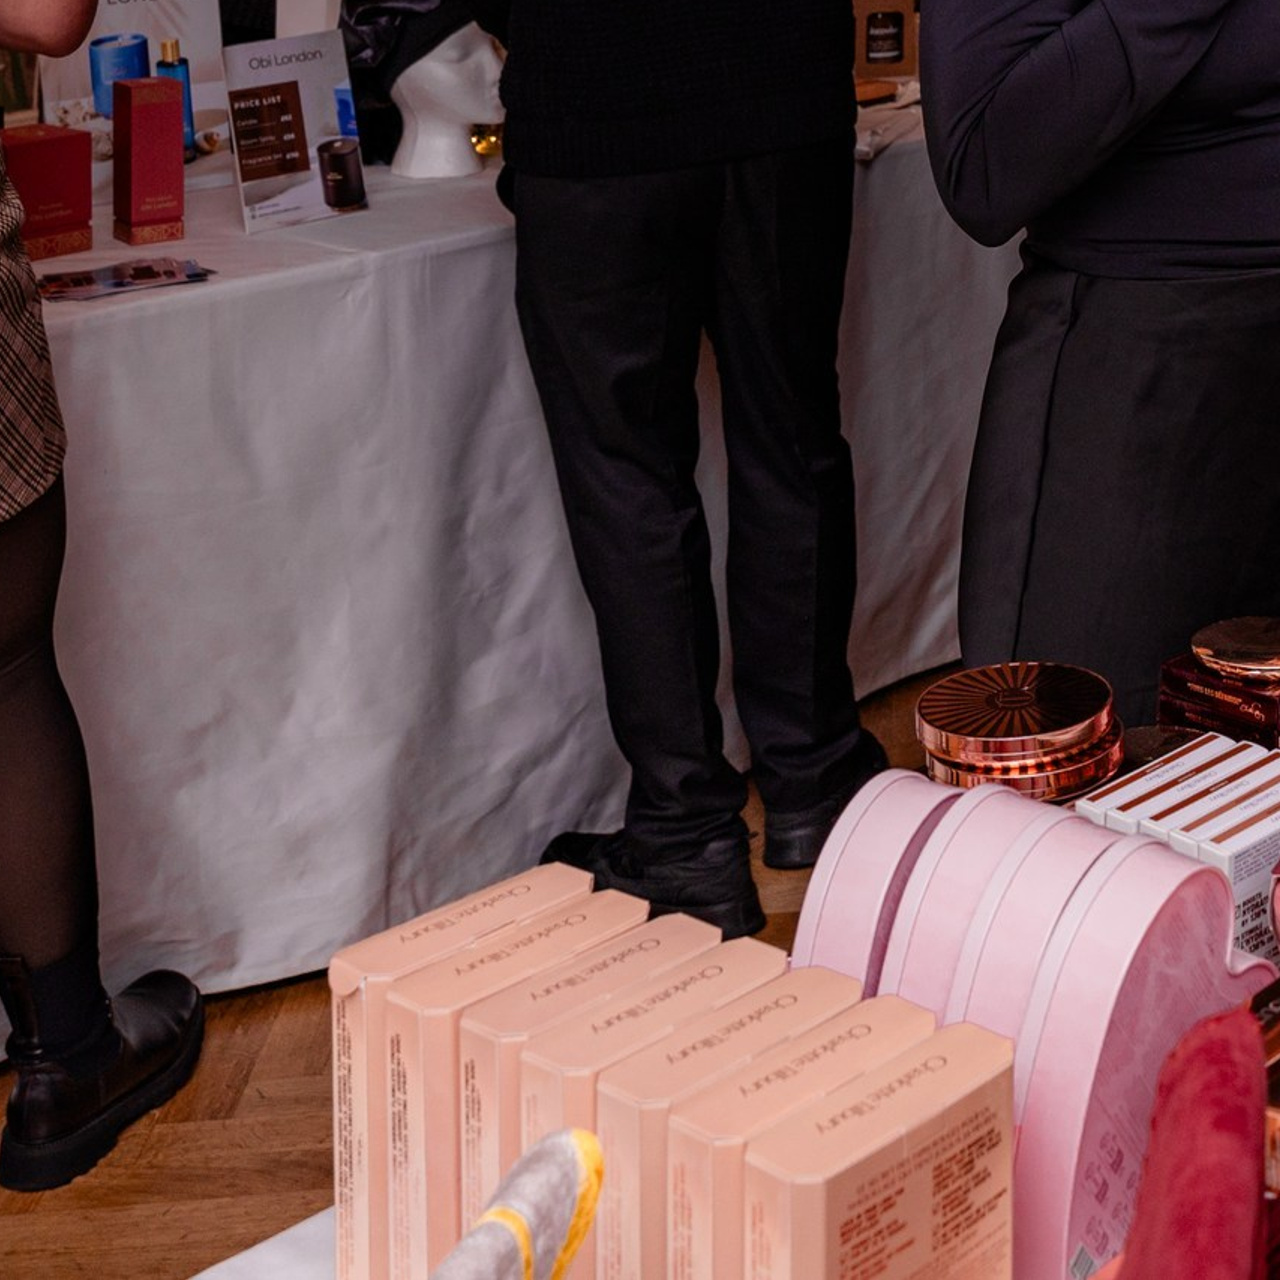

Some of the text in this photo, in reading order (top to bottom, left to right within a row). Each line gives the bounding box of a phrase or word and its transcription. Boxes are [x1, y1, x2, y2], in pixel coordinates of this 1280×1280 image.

[248, 48, 323, 71] Obi London
[233, 94, 283, 111] PRICE LIST
[400, 884, 532, 944] Charlotte Tilbury
[454, 913, 587, 977] Charlotte Tilbury
[530, 938, 661, 1002] Charlotte Tilbury
[591, 964, 724, 1036] Charlotte Tilbury
[666, 993, 798, 1066] Charlotte Tilbury
[739, 1023, 872, 1099] Charlotte Tilbury
[815, 1055, 948, 1135] Charlotte Tilbury
